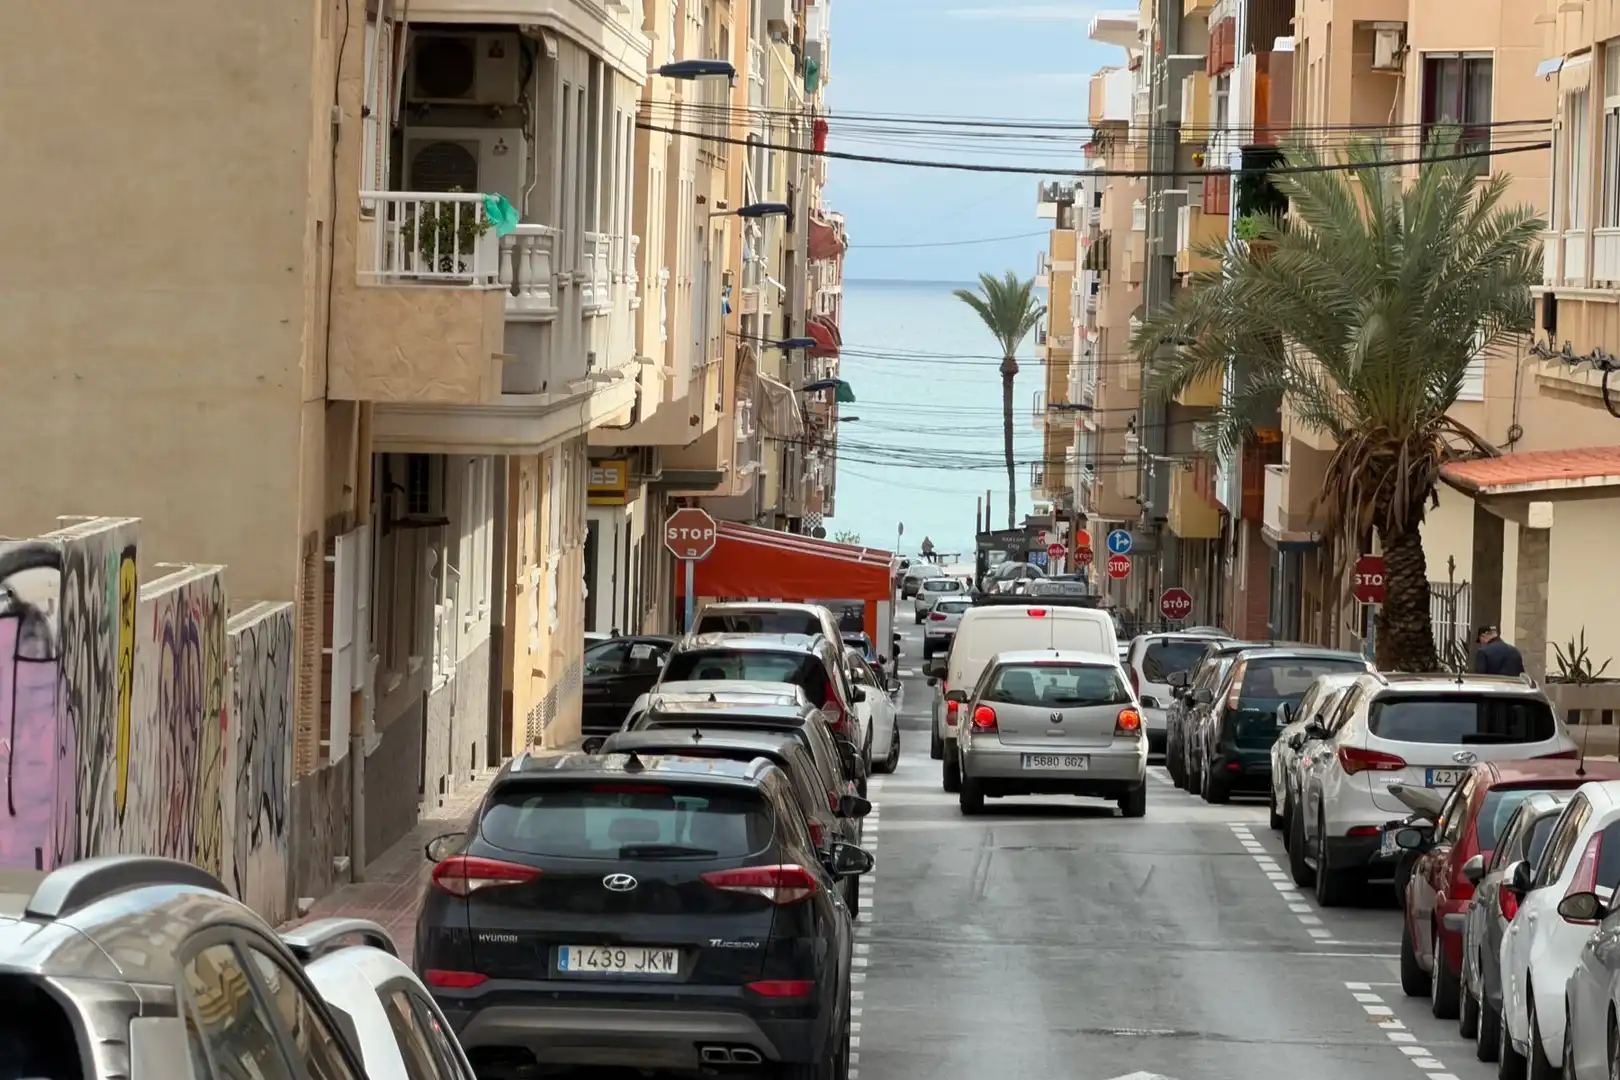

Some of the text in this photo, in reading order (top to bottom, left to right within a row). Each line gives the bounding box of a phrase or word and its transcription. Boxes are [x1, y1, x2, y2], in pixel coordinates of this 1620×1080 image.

[668, 528, 713, 540] STOP
[1108, 561, 1130, 572] STOP
[1355, 574, 1387, 586] STO
[1163, 600, 1190, 609] STOP
[1033, 756, 1060, 767] 5680
[479, 934, 518, 943] HYUNDAI
[709, 938, 760, 949] TUCSON
[577, 949, 673, 970] 1439 JKW
